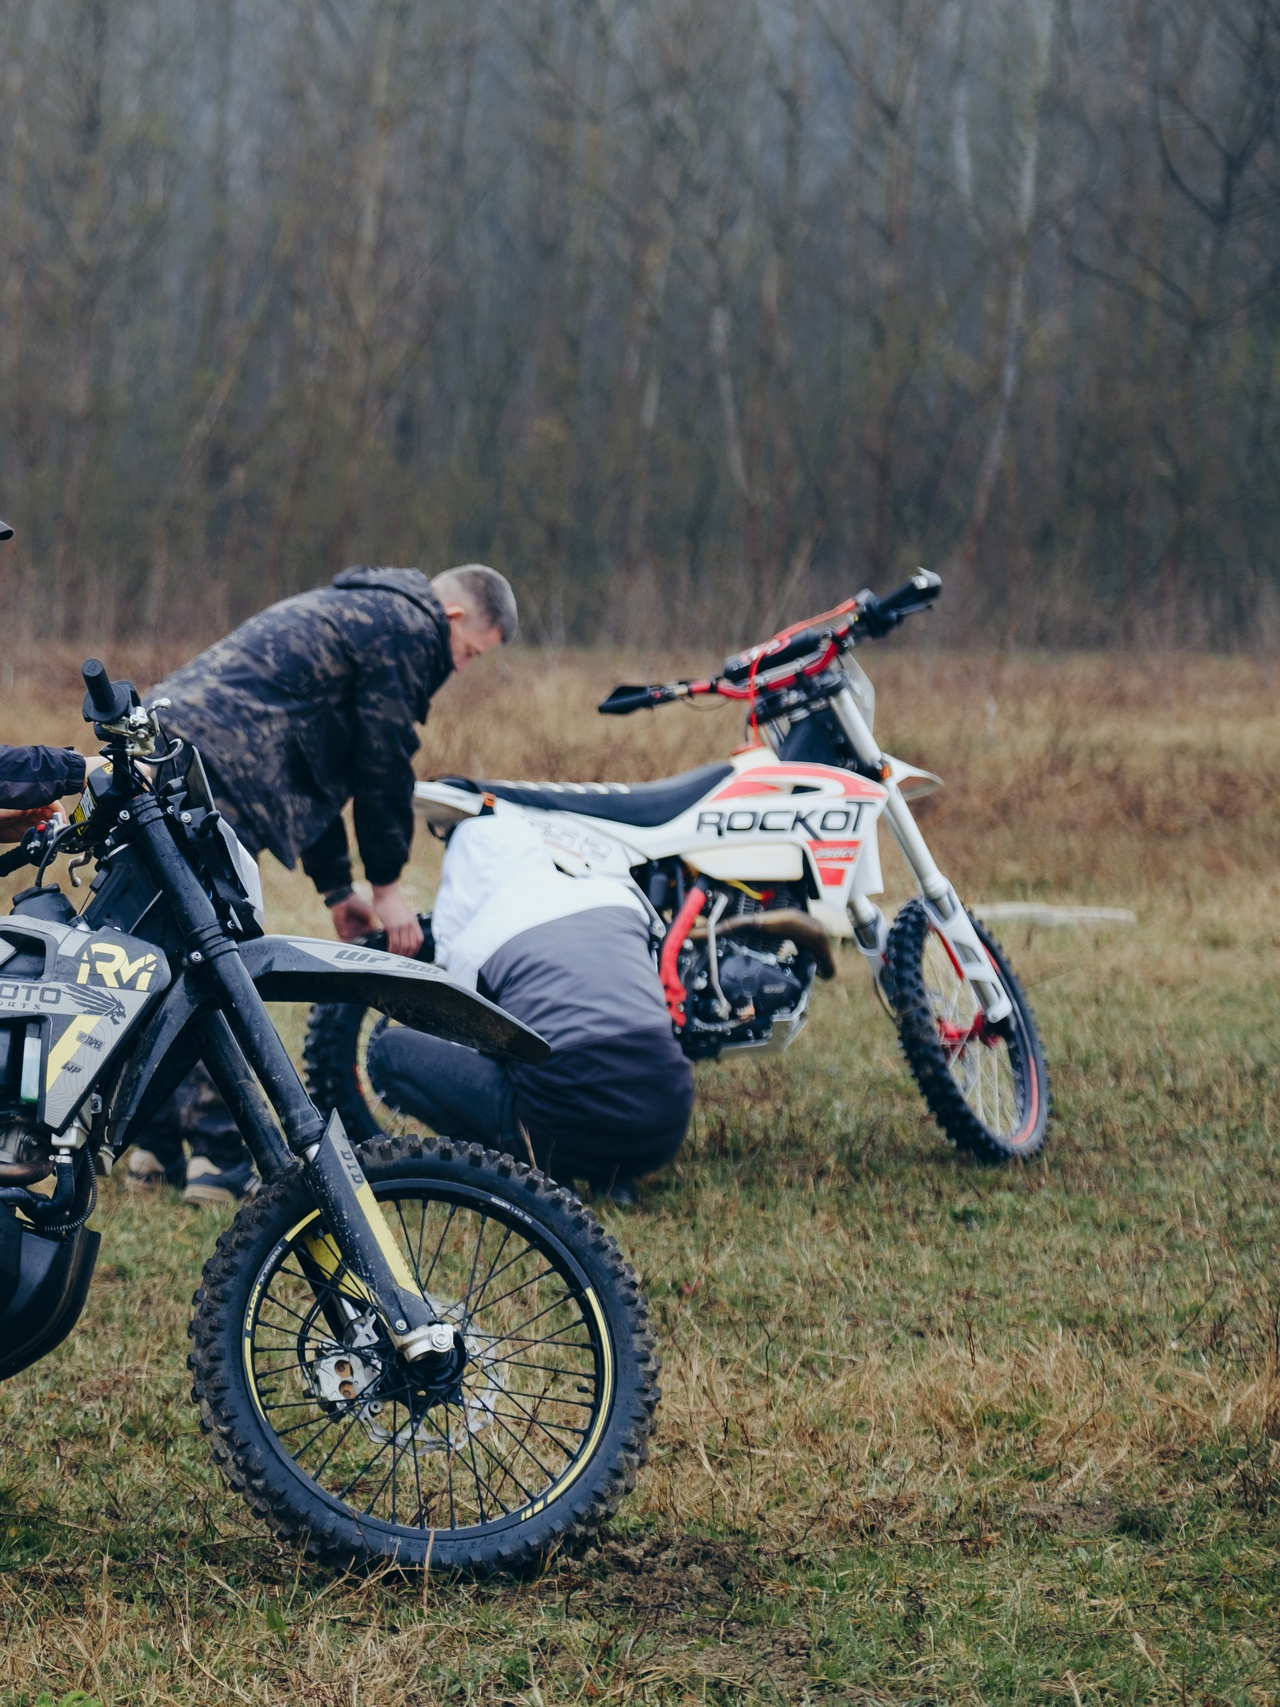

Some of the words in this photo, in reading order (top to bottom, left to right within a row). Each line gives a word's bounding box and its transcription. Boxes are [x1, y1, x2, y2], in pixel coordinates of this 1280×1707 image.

[696, 801, 875, 842] ROCKOT
[334, 949, 392, 964] WP
[397, 961, 441, 975] 300
[340, 1149, 365, 1184] DID
[245, 1246, 283, 1331] REGULMOTO
